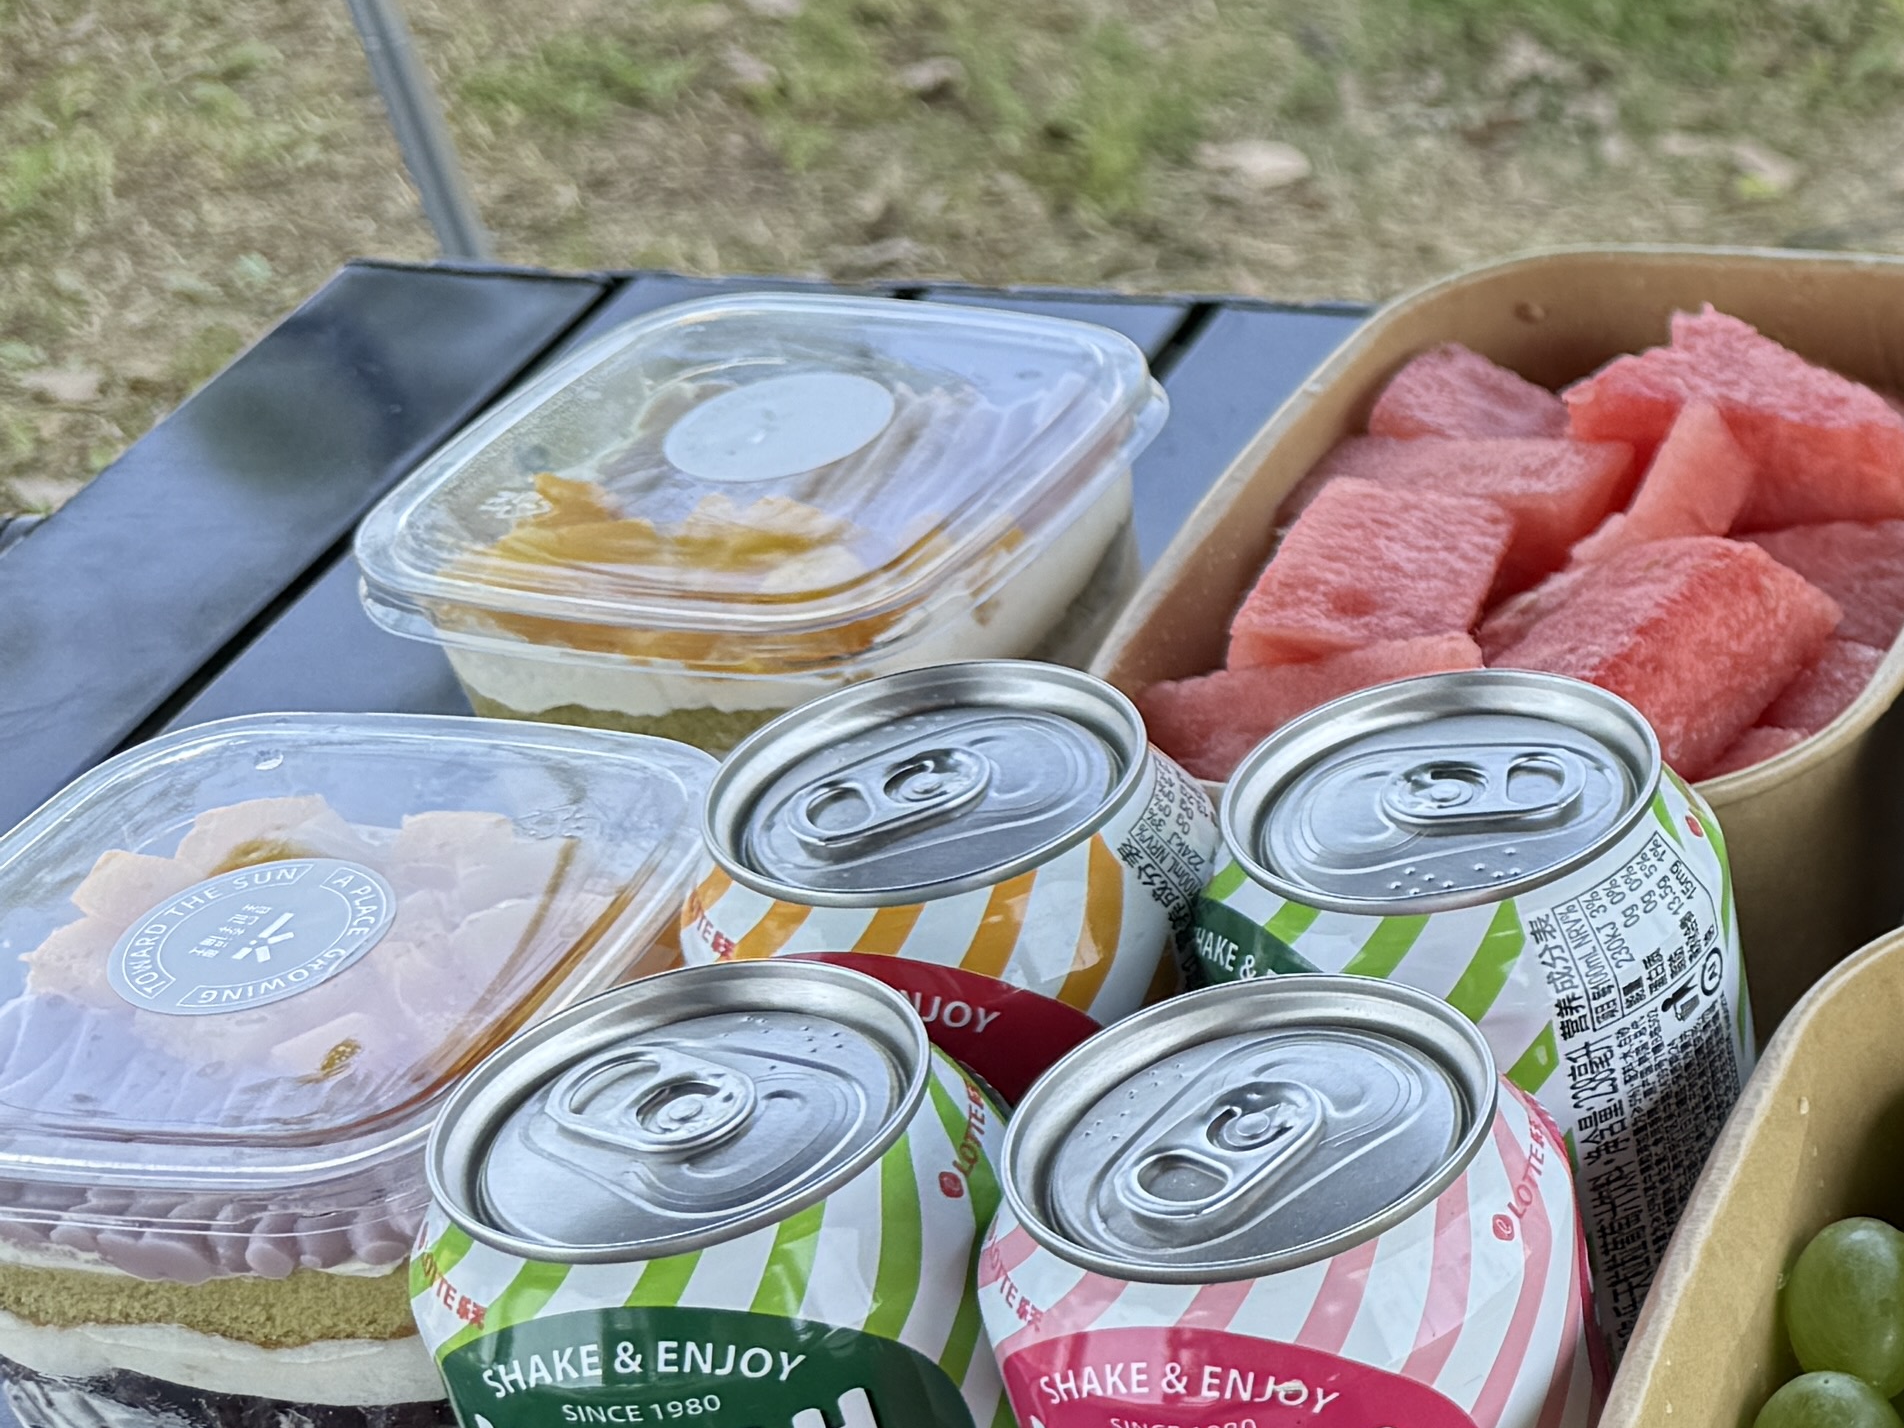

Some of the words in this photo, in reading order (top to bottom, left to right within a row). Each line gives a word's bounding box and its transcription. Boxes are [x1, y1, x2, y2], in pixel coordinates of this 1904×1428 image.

[332, 874, 352, 889] A
[1117, 838, 1194, 934] 养成分表
[1620, 865, 1643, 893] 0%
[1636, 851, 1658, 880] 5%
[1668, 859, 1697, 901] 15mg
[345, 885, 378, 938] PLACE
[1585, 891, 1608, 920] 3%
[1606, 878, 1627, 907] 0%
[1640, 893, 1658, 914] 0g
[1656, 875, 1684, 916] 13.5g
[129, 923, 168, 996] TOWARD
[164, 887, 220, 917] THE
[232, 867, 299, 890] SUN
[1560, 904, 1592, 950] NRV%
[1622, 907, 1641, 929] 0g
[1193, 926, 1239, 972] HAKE
[1240, 954, 1256, 980] &
[1596, 921, 1636, 970] 230kJ
[198, 948, 347, 1005] GROWING
[1528, 913, 1592, 1041] 营养成分表
[901, 989, 1000, 1033] NJOY
[953, 1103, 986, 1178] LOTTE
[1507, 1143, 1545, 1219] LOTTE
[482, 1343, 603, 1399] SHAKE
[613, 1341, 643, 1373] &
[656, 1340, 807, 1384] ENJOY
[1038, 1360, 1149, 1406] SHAKE
[1160, 1361, 1190, 1395] &
[1202, 1367, 1340, 1415] ENJOY
[562, 1401, 643, 1424] SINCE
[649, 1394, 722, 1422] 1980
